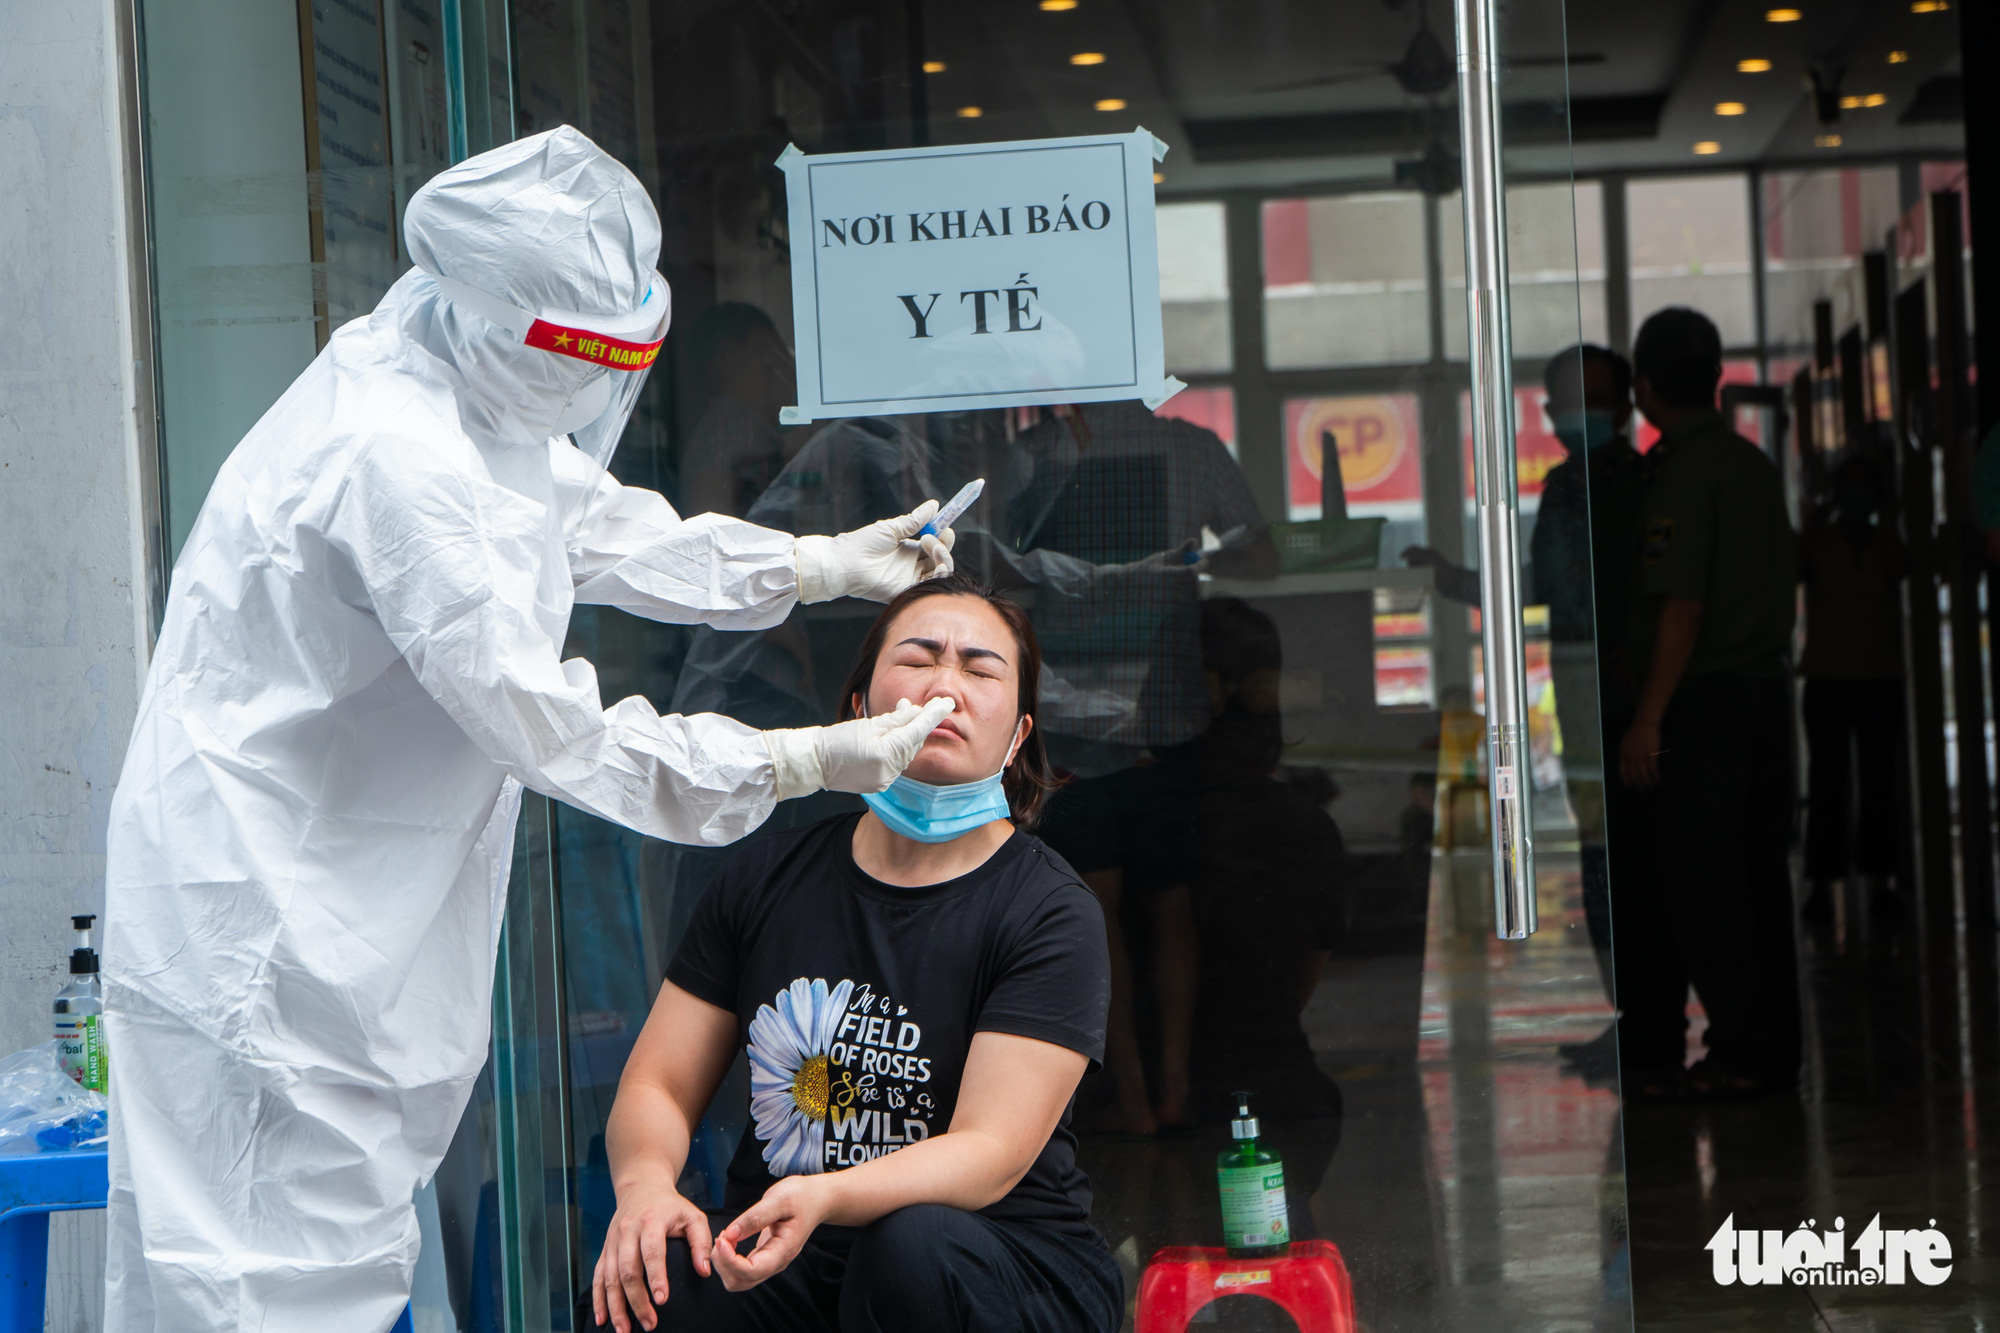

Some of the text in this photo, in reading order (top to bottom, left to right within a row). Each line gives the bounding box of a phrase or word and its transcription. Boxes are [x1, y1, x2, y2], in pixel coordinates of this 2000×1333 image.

[822, 194, 1110, 248] NƠI KHAI BÁO
[897, 272, 1042, 339] Y TẾ
[577, 337, 607, 359] VIỆT
[608, 347, 643, 365] NAM
[880, 996, 890, 1014] a
[837, 1013, 921, 1051] FIELD
[89, 1026, 98, 1083] HAND WASH
[830, 1042, 931, 1082] OF ROSES
[830, 1071, 935, 1109] She is a
[830, 1105, 928, 1143] WILD
